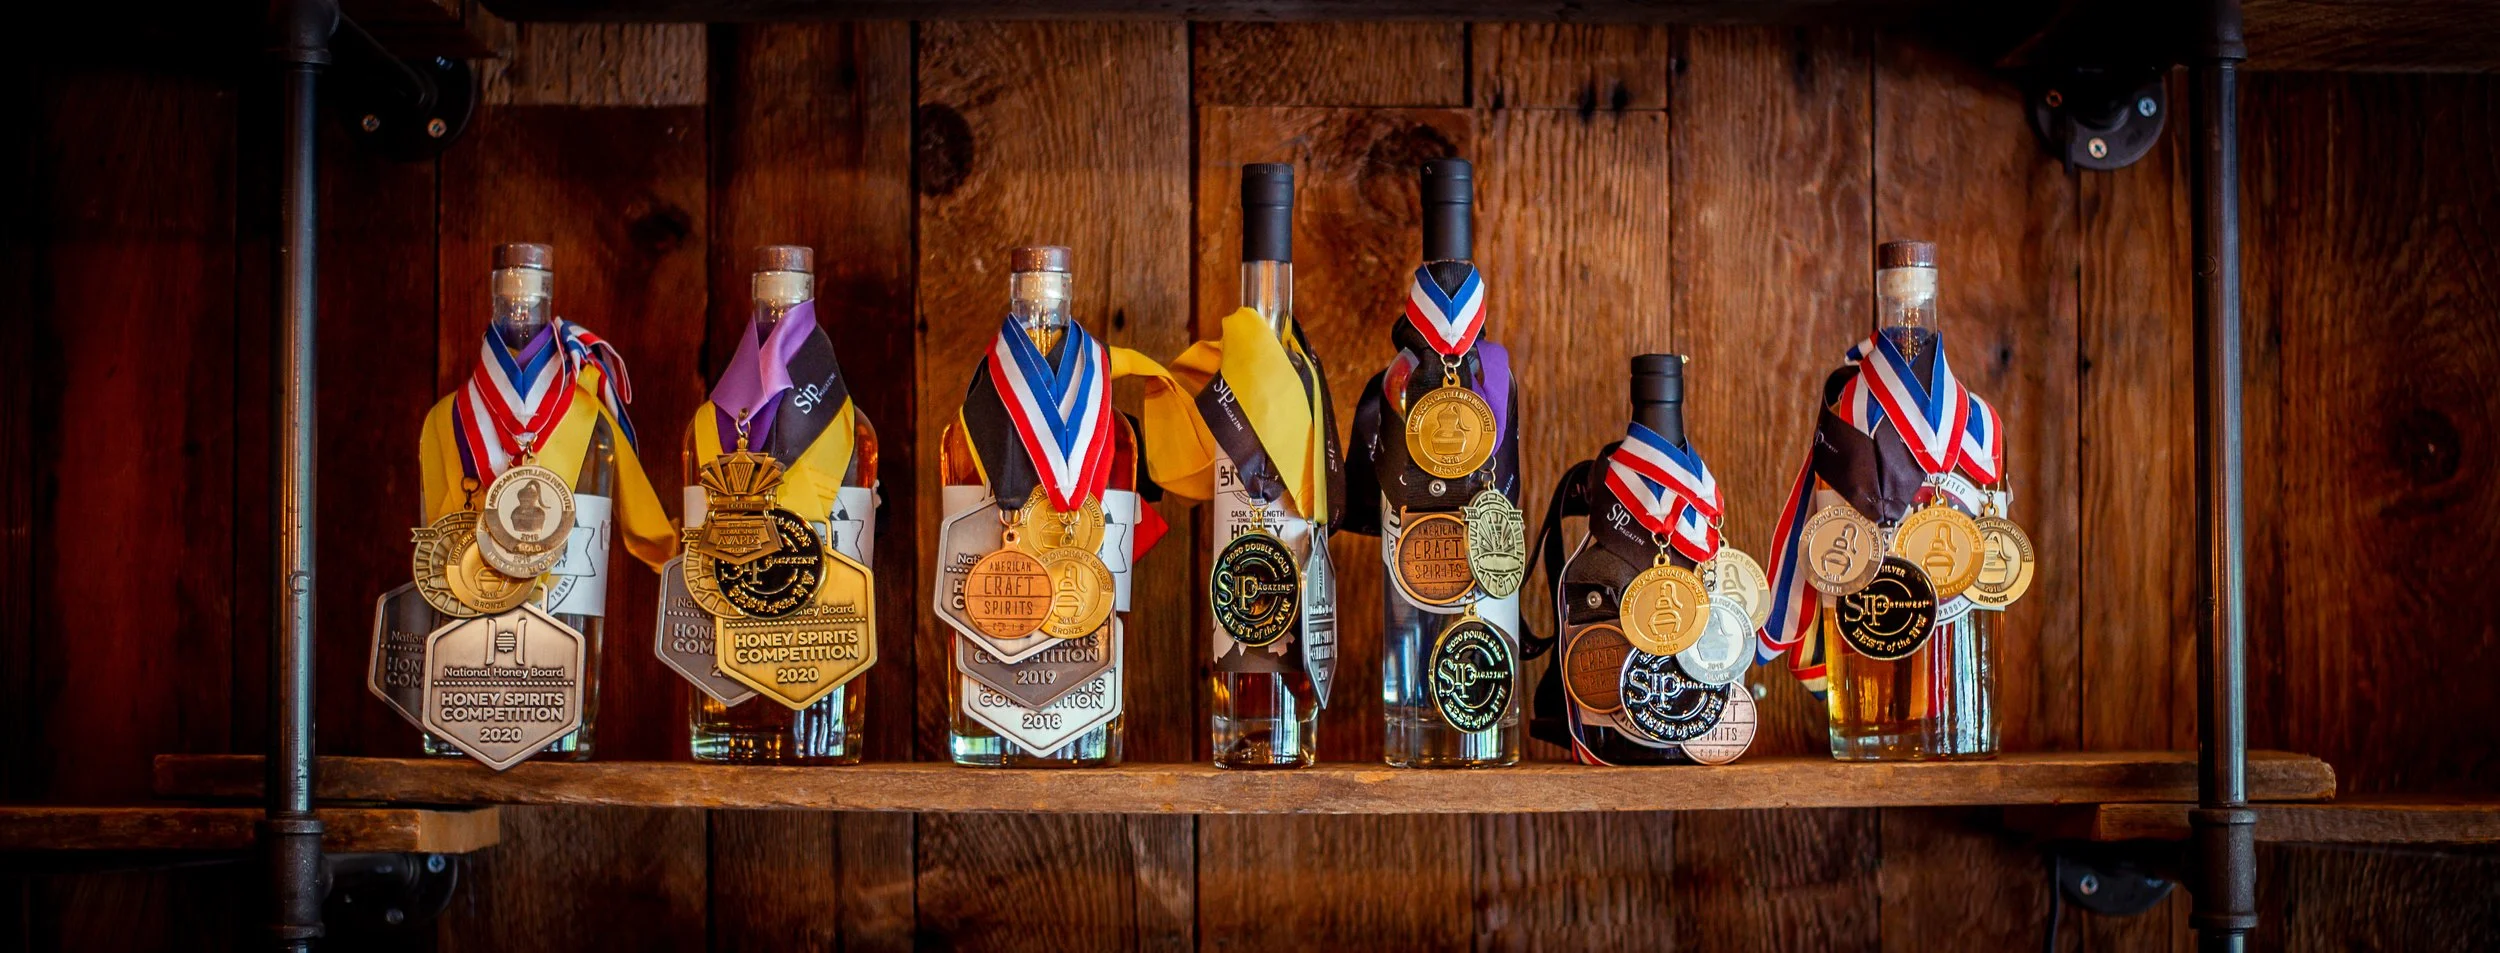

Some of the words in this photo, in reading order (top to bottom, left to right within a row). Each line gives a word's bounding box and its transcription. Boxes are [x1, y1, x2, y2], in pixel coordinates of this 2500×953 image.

[794, 383, 822, 415] Sip
[1222, 402, 1244, 431] MAGAZINE
[1411, 398, 1435, 431] AMERICAN
[1434, 391, 1471, 402] DISTILLING
[1471, 398, 1494, 432] INSTITUTE
[1433, 465, 1466, 475] BRONZE
[513, 469, 551, 480] DISTILLING
[550, 477, 572, 512] INSTITUTE
[1231, 510, 1247, 518] CASK
[1419, 525, 1458, 536] AMERICAN
[1606, 503, 1631, 530] Sip
[1619, 526, 1645, 546] MAGAZINE
[718, 535, 760, 545] AWARDS
[1847, 509, 1871, 527] CRAFT
[1868, 526, 1880, 559] SPIRITS
[518, 543, 542, 552] GOLD
[1414, 540, 1461, 559] CRAFT
[2010, 527, 2030, 562] INSTITUTE
[1245, 543, 1273, 555] DOUBLE
[1273, 552, 1291, 574] GOLD
[1720, 551, 1744, 561] CRAFT
[989, 561, 1031, 572] AMERICAN
[1415, 563, 1462, 579] SPIRITS
[1881, 565, 1906, 577] SILVER
[551, 577, 572, 600] 750ML
[984, 576, 1034, 596] CRAFT
[1217, 565, 1259, 611] Sip
[1658, 569, 1686, 580] CRAFT
[1686, 575, 1706, 605] SPIRITS
[1816, 580, 1842, 593] SILVER
[474, 601, 507, 609] BRONZE
[1845, 587, 1890, 626] Sip
[1978, 594, 2008, 603] BRONZE
[822, 604, 856, 615] Board
[984, 601, 1033, 615] SPIRITS
[1938, 600, 1963, 617] PROOF
[1224, 612, 1253, 638] BEST
[1254, 629, 1263, 640] of
[1264, 624, 1277, 636] the
[1275, 598, 1292, 624] NW
[391, 630, 425, 643] Nation
[674, 623, 717, 640] HONE
[1052, 626, 1084, 635] BRONZE
[1463, 630, 1490, 642] DOUBLE
[734, 633, 793, 648] HONEY
[798, 630, 858, 646] SPIRITS
[1852, 627, 1885, 651] BEST
[1887, 643, 1896, 653] of
[1897, 637, 1911, 649] the
[736, 645, 859, 663] COMPETITION
[1656, 643, 1679, 653] GOLD
[388, 656, 424, 673] HON
[444, 667, 491, 677] National
[493, 667, 529, 680] Honey
[531, 667, 564, 677] Board
[777, 668, 820, 683] 2020
[1017, 670, 1057, 685] 2019
[1438, 653, 1477, 698] Sip
[1706, 673, 1730, 681] SILVER
[1628, 663, 1681, 711] Sip
[441, 692, 501, 706] HONEY
[504, 692, 565, 706] SPIRITS
[441, 707, 564, 721] COMPETITION
[1022, 713, 1062, 729] 2018
[480, 728, 522, 742] 2020
